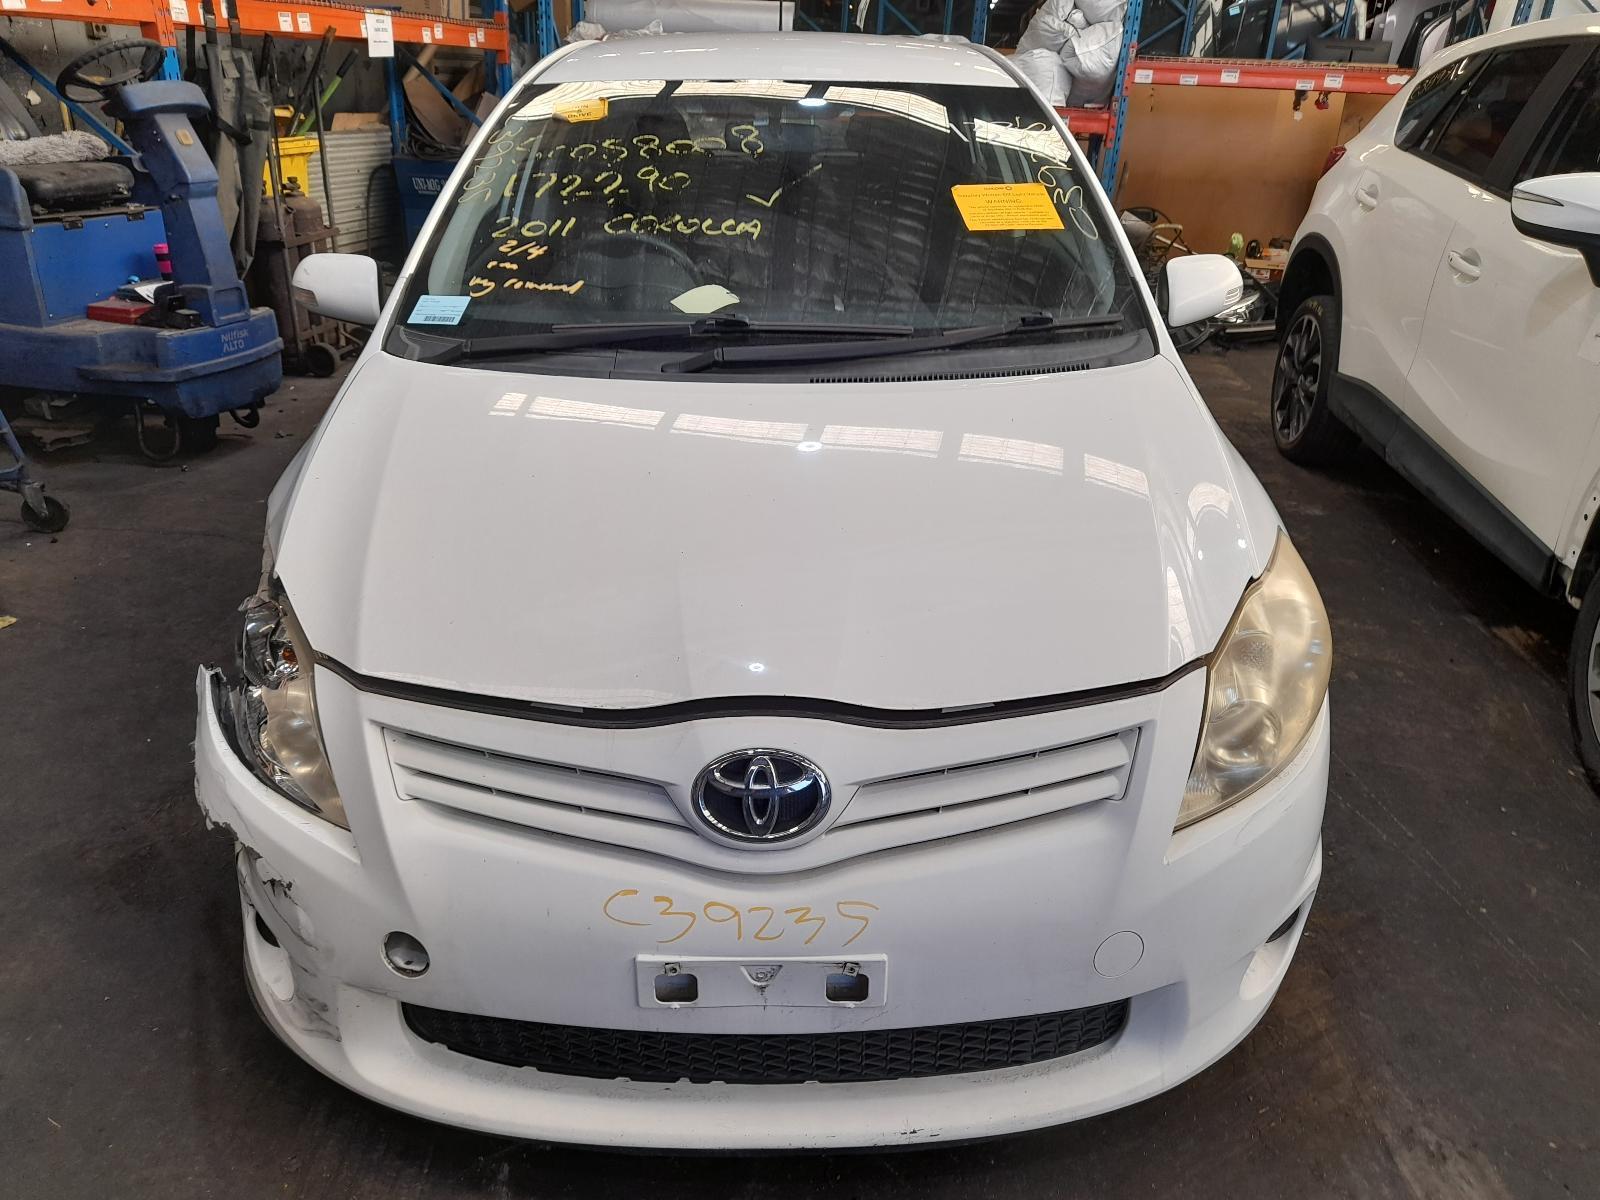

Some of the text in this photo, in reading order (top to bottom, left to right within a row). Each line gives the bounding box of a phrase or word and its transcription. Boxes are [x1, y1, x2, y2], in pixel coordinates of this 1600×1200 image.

[492, 212, 763, 241] 2011 COROLLA
[223, 339, 245, 352] ALTO
[603, 889, 879, 947] C39235
